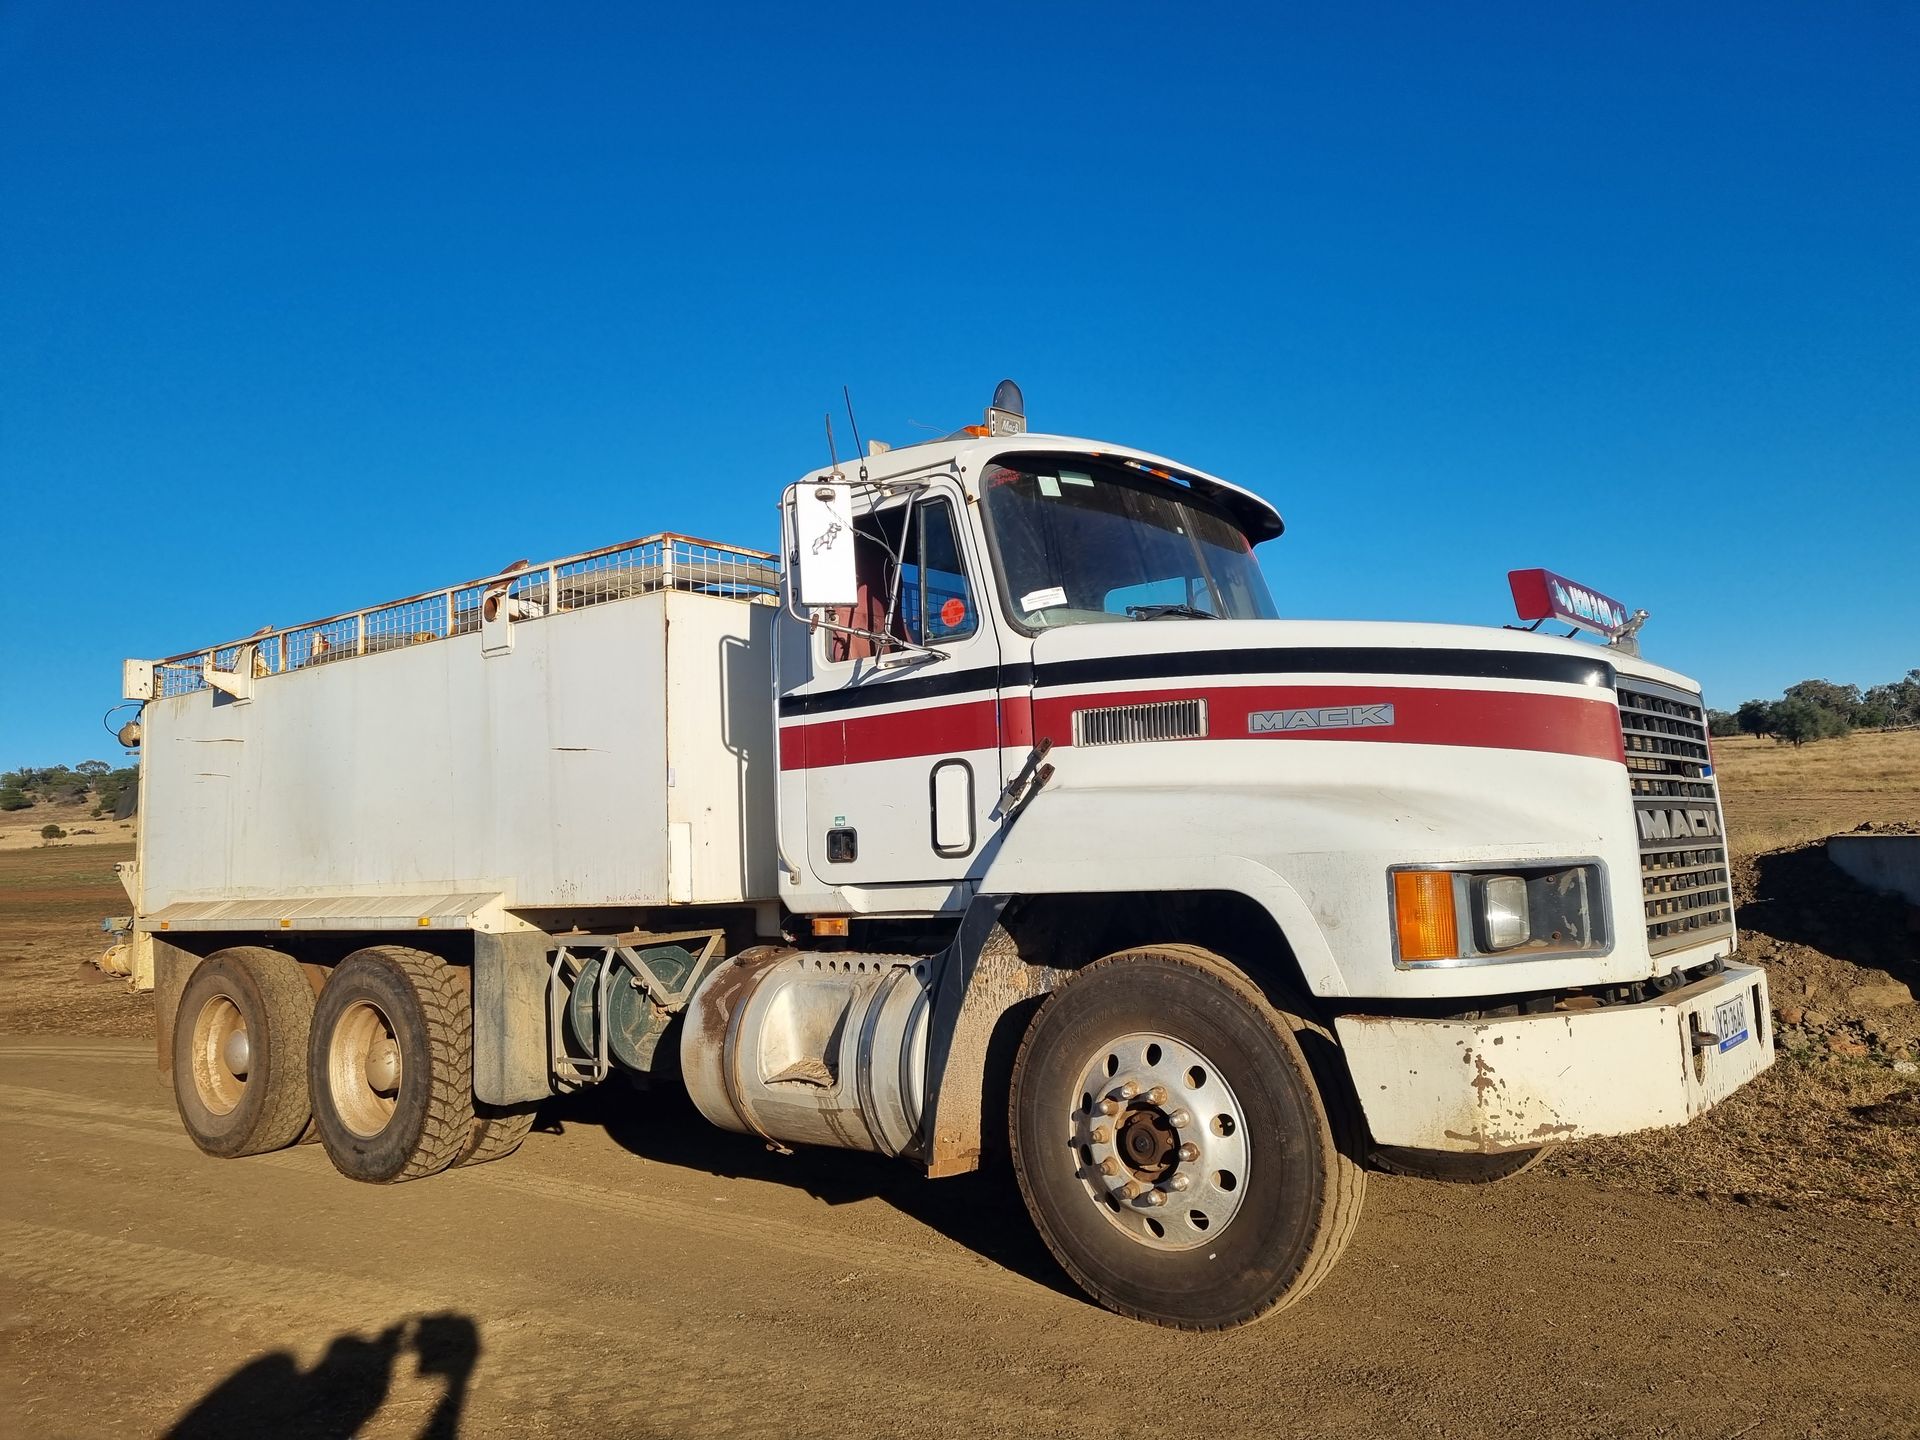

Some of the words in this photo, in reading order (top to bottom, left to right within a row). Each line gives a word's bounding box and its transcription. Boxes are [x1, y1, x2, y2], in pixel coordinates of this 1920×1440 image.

[1002, 420, 1019, 433] Mack
[1252, 703, 1393, 732] MACK
[1637, 808, 1721, 840] MACK
